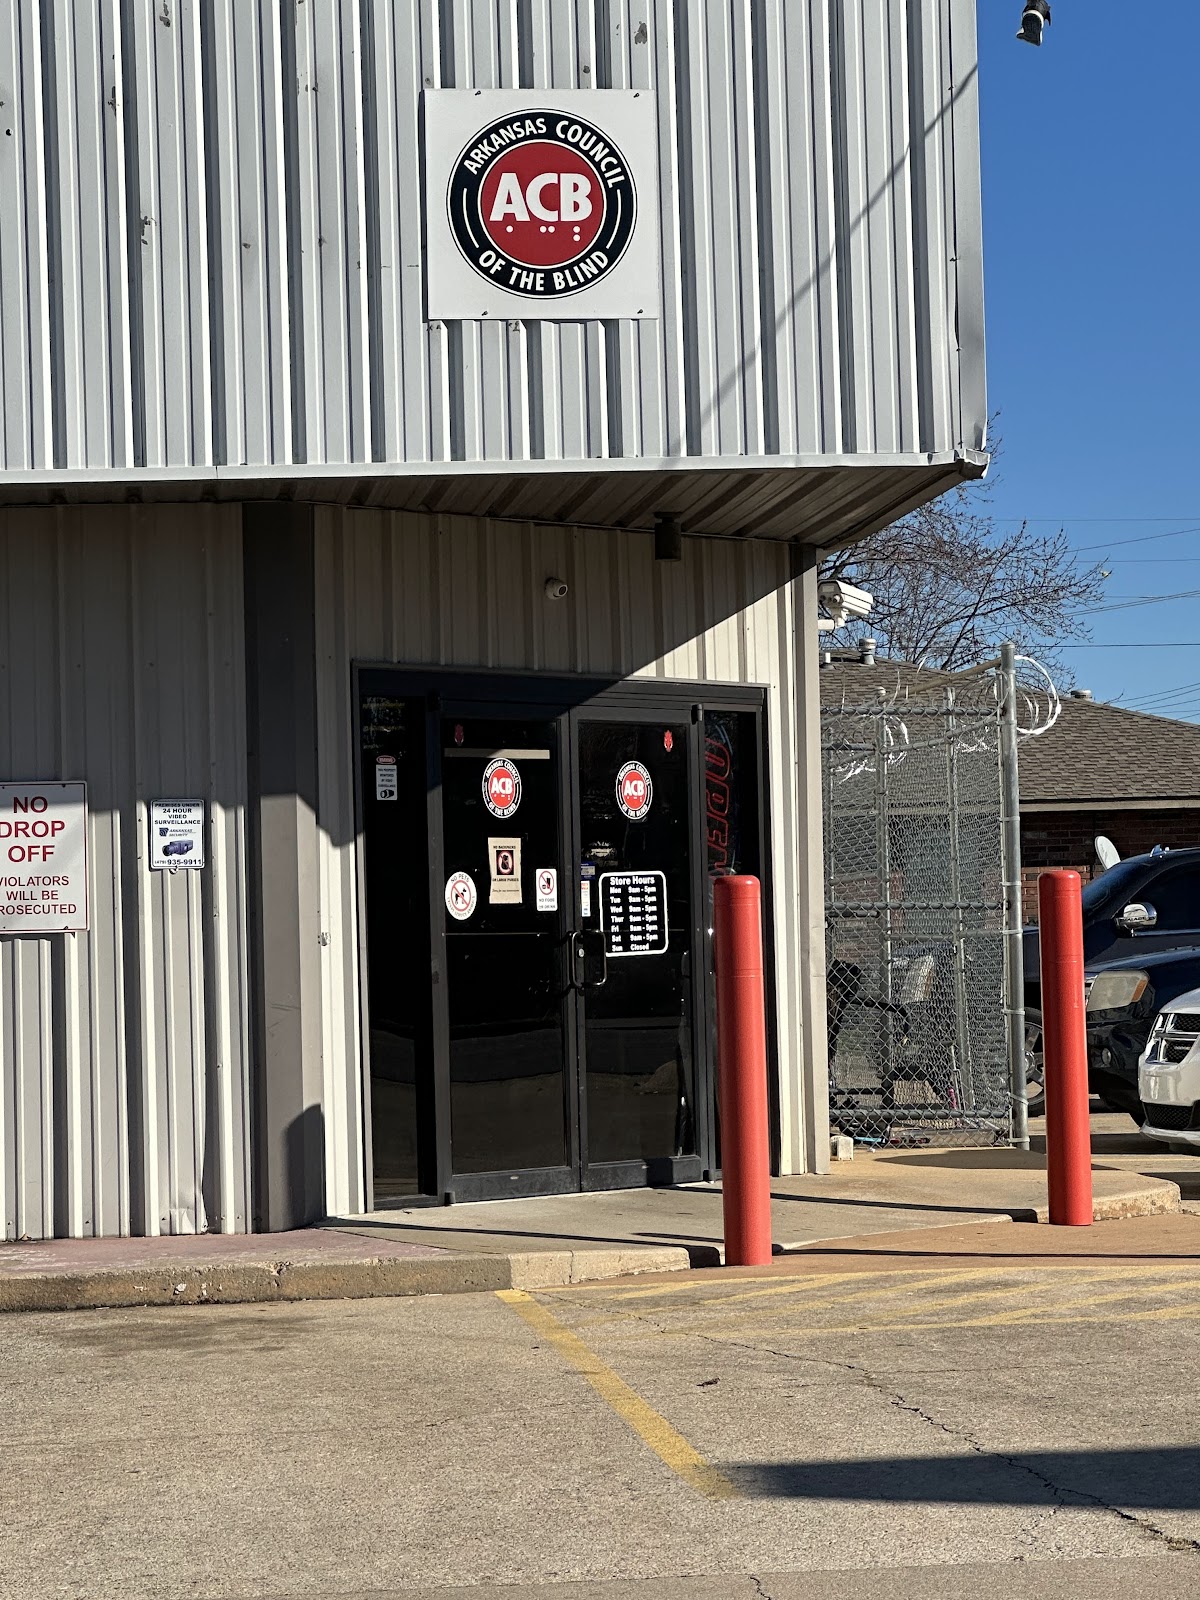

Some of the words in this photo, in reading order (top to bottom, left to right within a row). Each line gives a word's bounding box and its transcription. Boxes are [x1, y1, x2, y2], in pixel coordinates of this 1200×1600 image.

[463, 118, 547, 175] ARKANSAS
[556, 120, 625, 188] COUNCIL
[490, 172, 592, 222] ACB
[479, 250, 506, 274] OF
[509, 267, 545, 291] THE
[552, 251, 608, 291] BLIND
[491, 777, 513, 794] ACB
[624, 780, 644, 796] ACB
[13, 796, 48, 813] NO
[0, 820, 65, 838] DROP
[8, 845, 55, 862] OFF
[610, 877, 631, 885] Store
[632, 876, 655, 884] Hours
[6, 890, 38, 900] WILL
[42, 890, 59, 900] BE
[645, 895, 656, 903] 5pm
[0, 904, 76, 915] ROSECUTED
[645, 905, 657, 913] 5pm
[645, 914, 657, 922] 5pm
[646, 924, 658, 932] 5pm
[646, 933, 658, 942] 5pm
